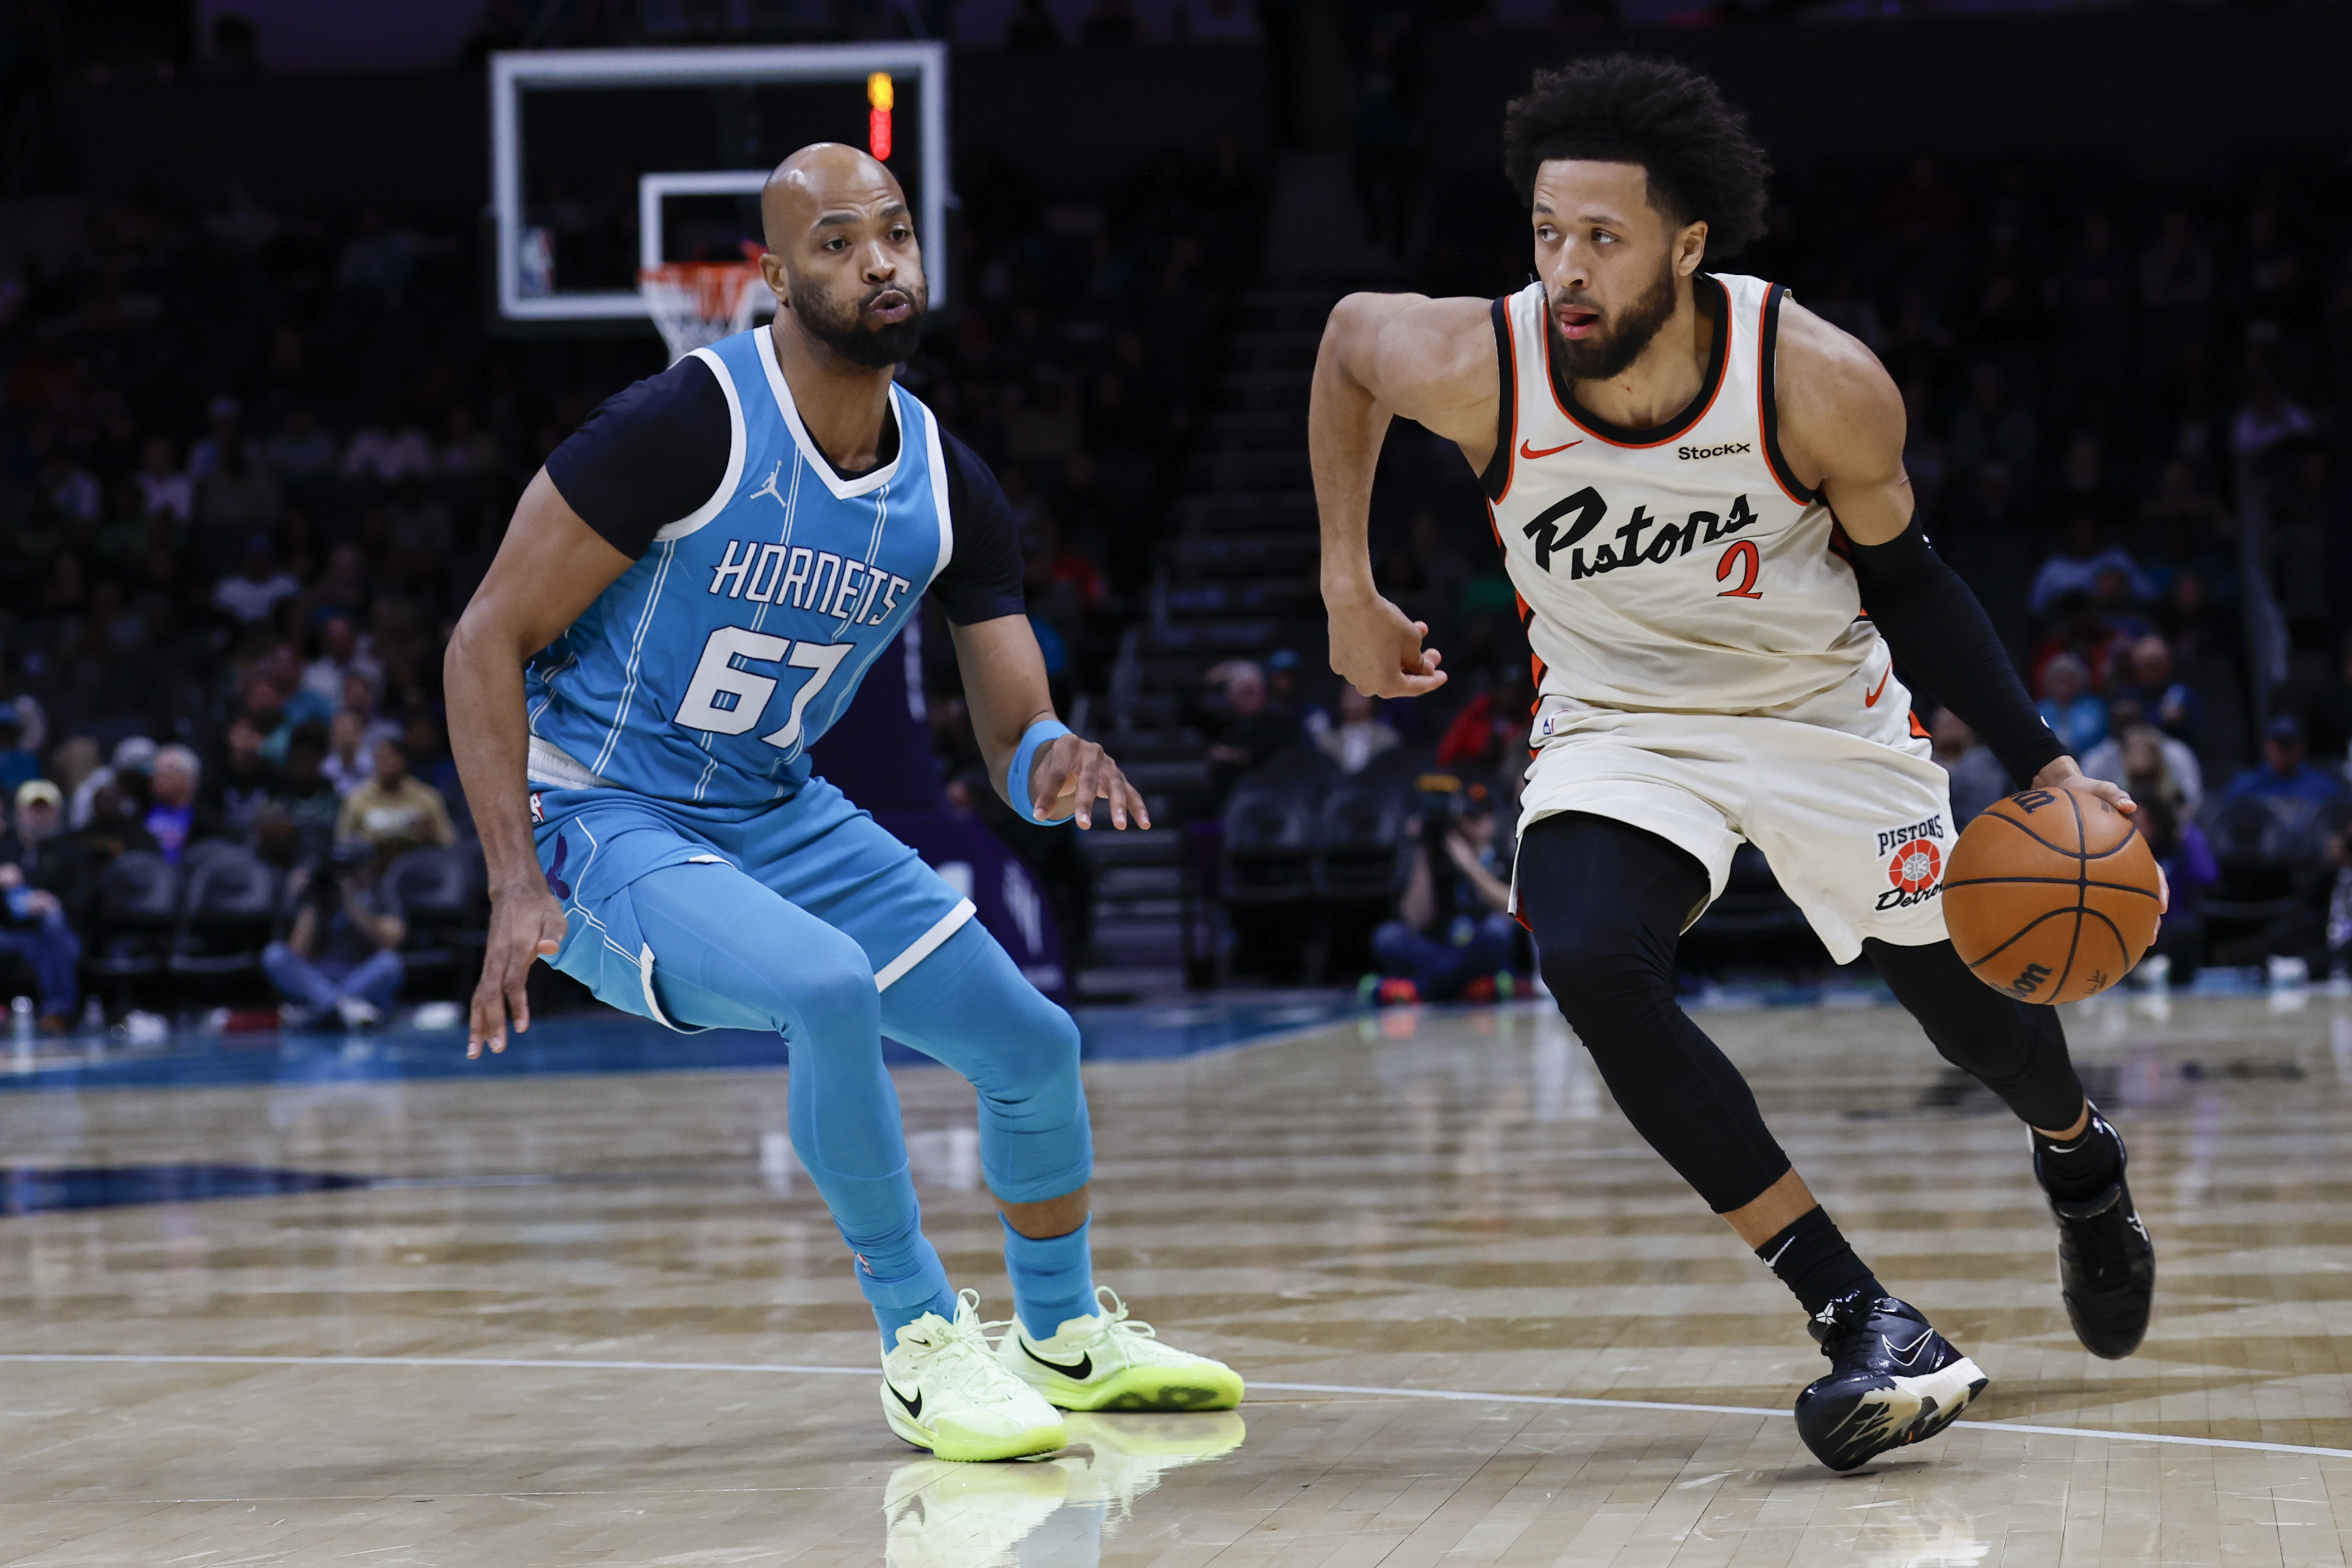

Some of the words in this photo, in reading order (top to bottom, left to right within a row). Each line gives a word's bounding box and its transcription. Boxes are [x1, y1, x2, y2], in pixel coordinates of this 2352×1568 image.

[1522, 486, 1759, 580] Pistons
[709, 540, 911, 626] HORNETS
[1716, 540, 1763, 599] 2
[672, 626, 856, 749] 67
[1878, 813, 1944, 857] PISTONS
[1875, 880, 1943, 911] Detro
